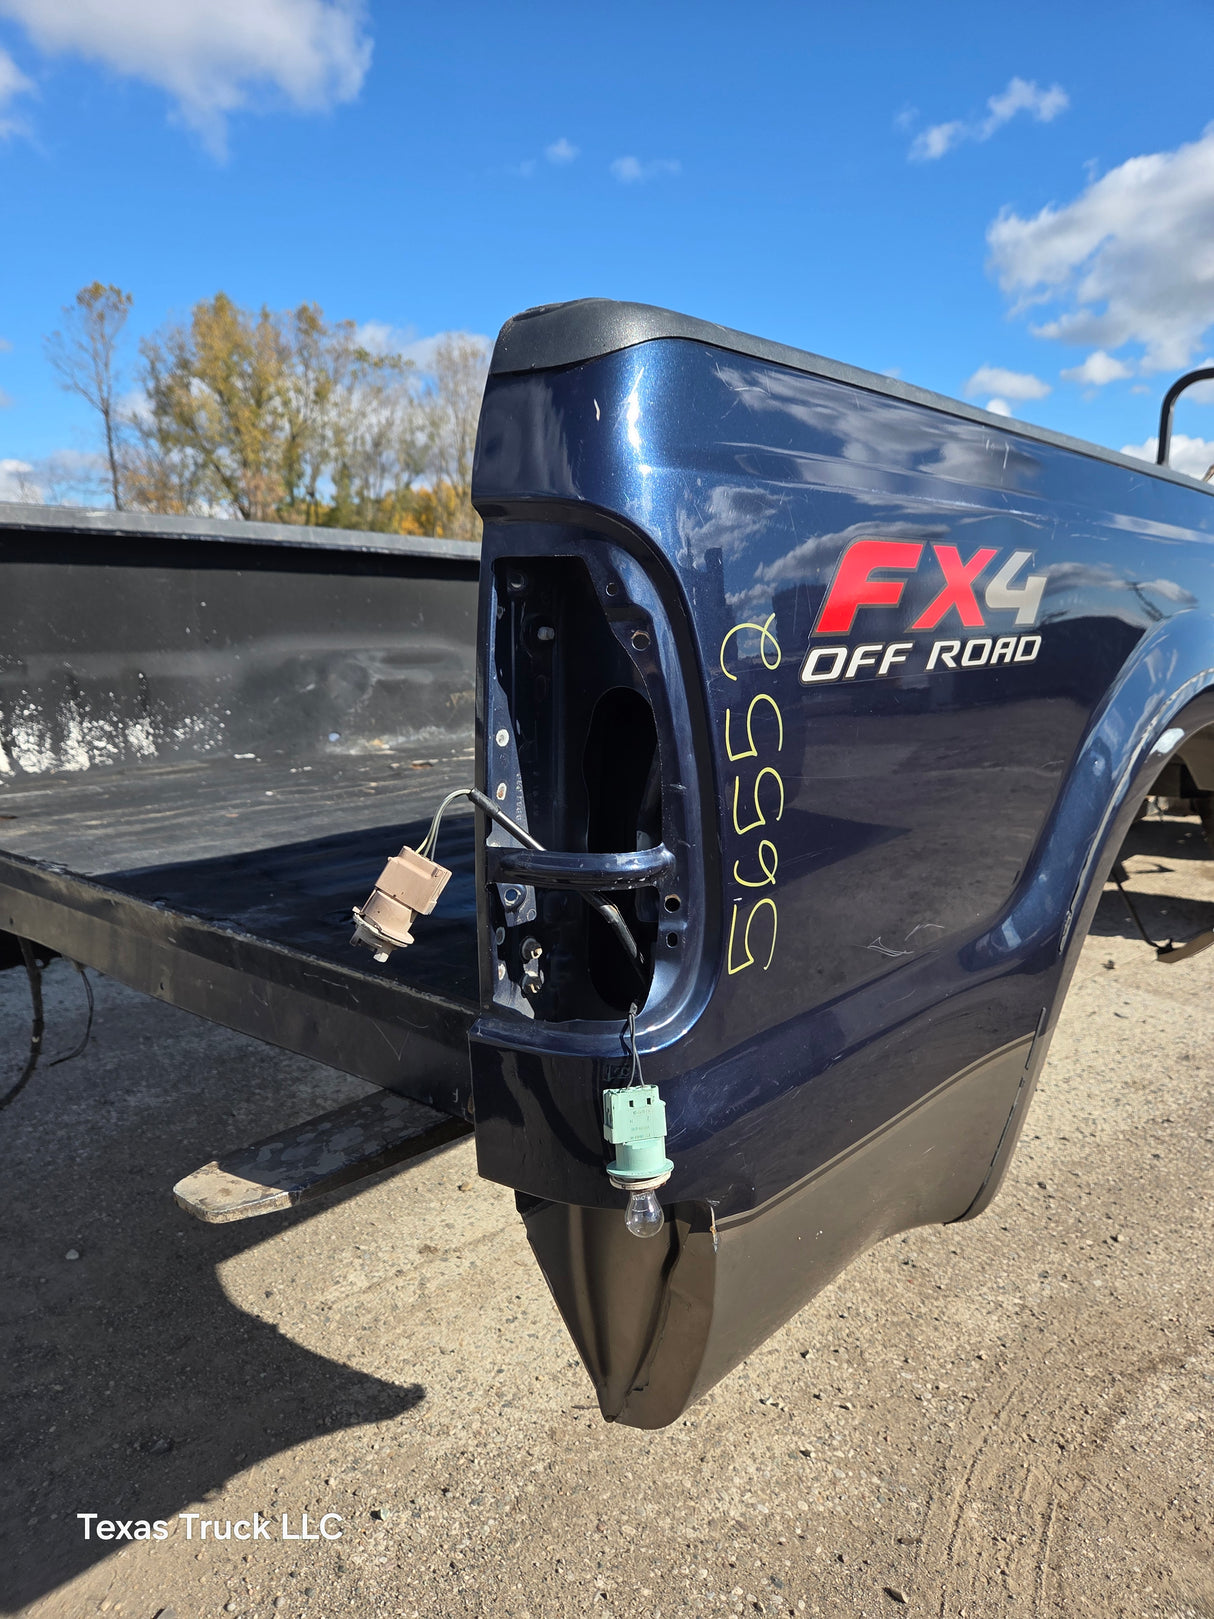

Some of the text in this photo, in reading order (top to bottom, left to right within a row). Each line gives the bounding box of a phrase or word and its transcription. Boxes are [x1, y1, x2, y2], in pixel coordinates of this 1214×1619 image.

[816, 540, 1047, 633] FX4
[801, 635, 1042, 683] OFF ROAD
[720, 613, 784, 975] 56552
